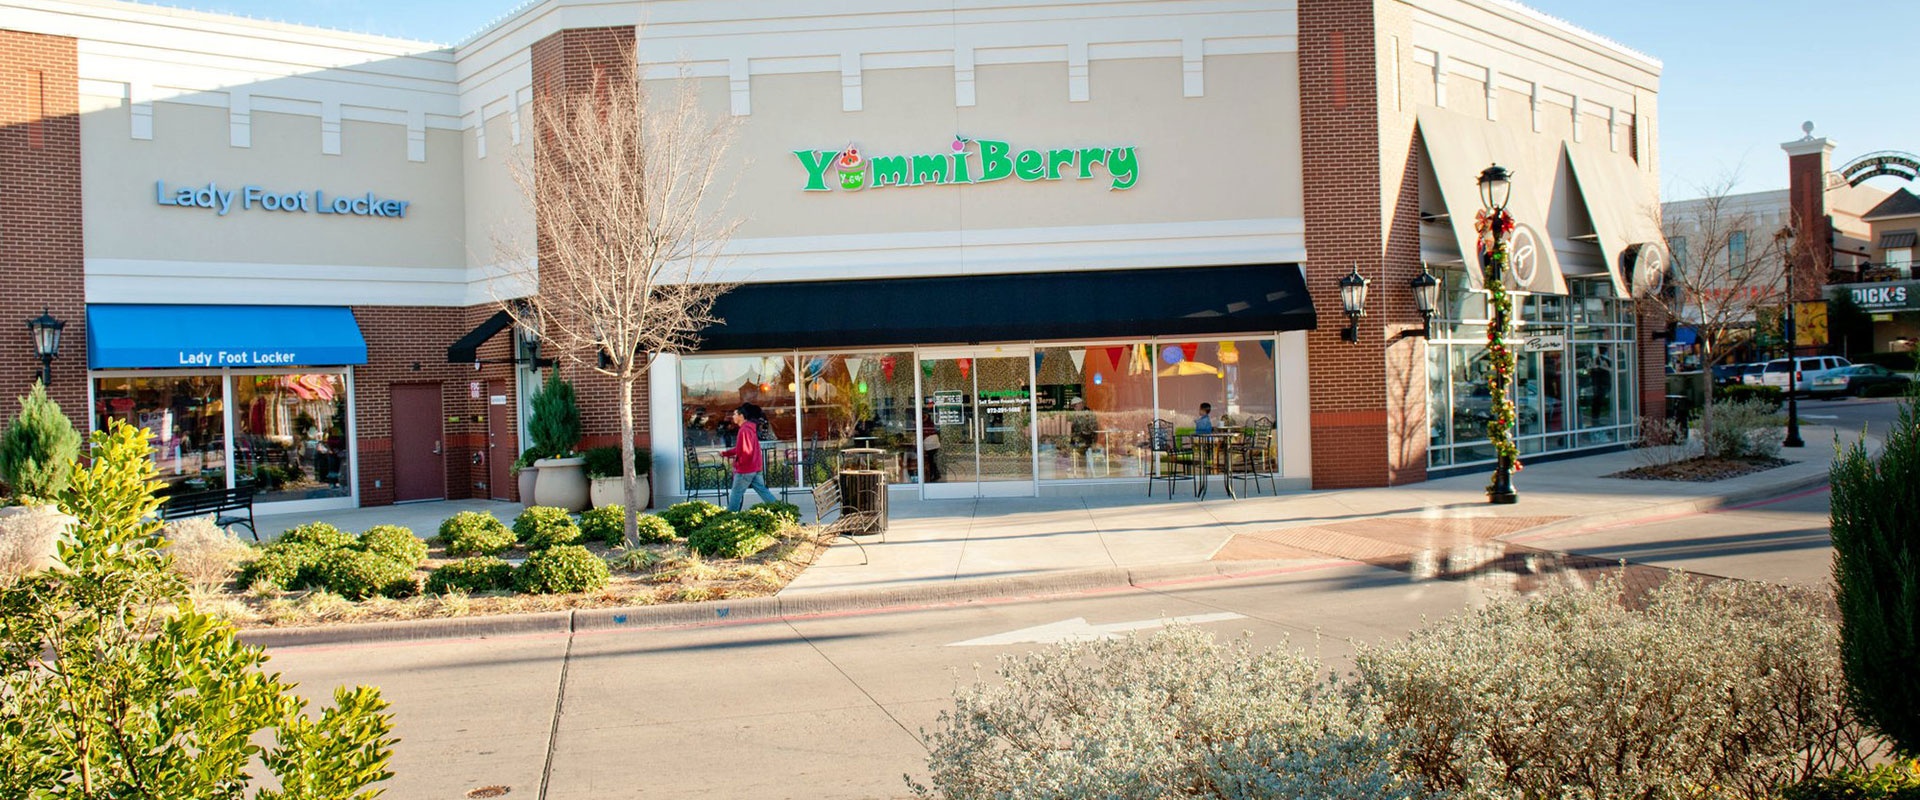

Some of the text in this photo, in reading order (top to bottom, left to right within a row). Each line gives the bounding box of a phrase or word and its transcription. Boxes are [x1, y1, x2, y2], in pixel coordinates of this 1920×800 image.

[1881, 157, 1919, 170] VILLAGE
[156, 180, 411, 218] Lady Foot Locker
[1852, 286, 1907, 304] DICK'S
[179, 351, 295, 367] Lady Foot Locker
